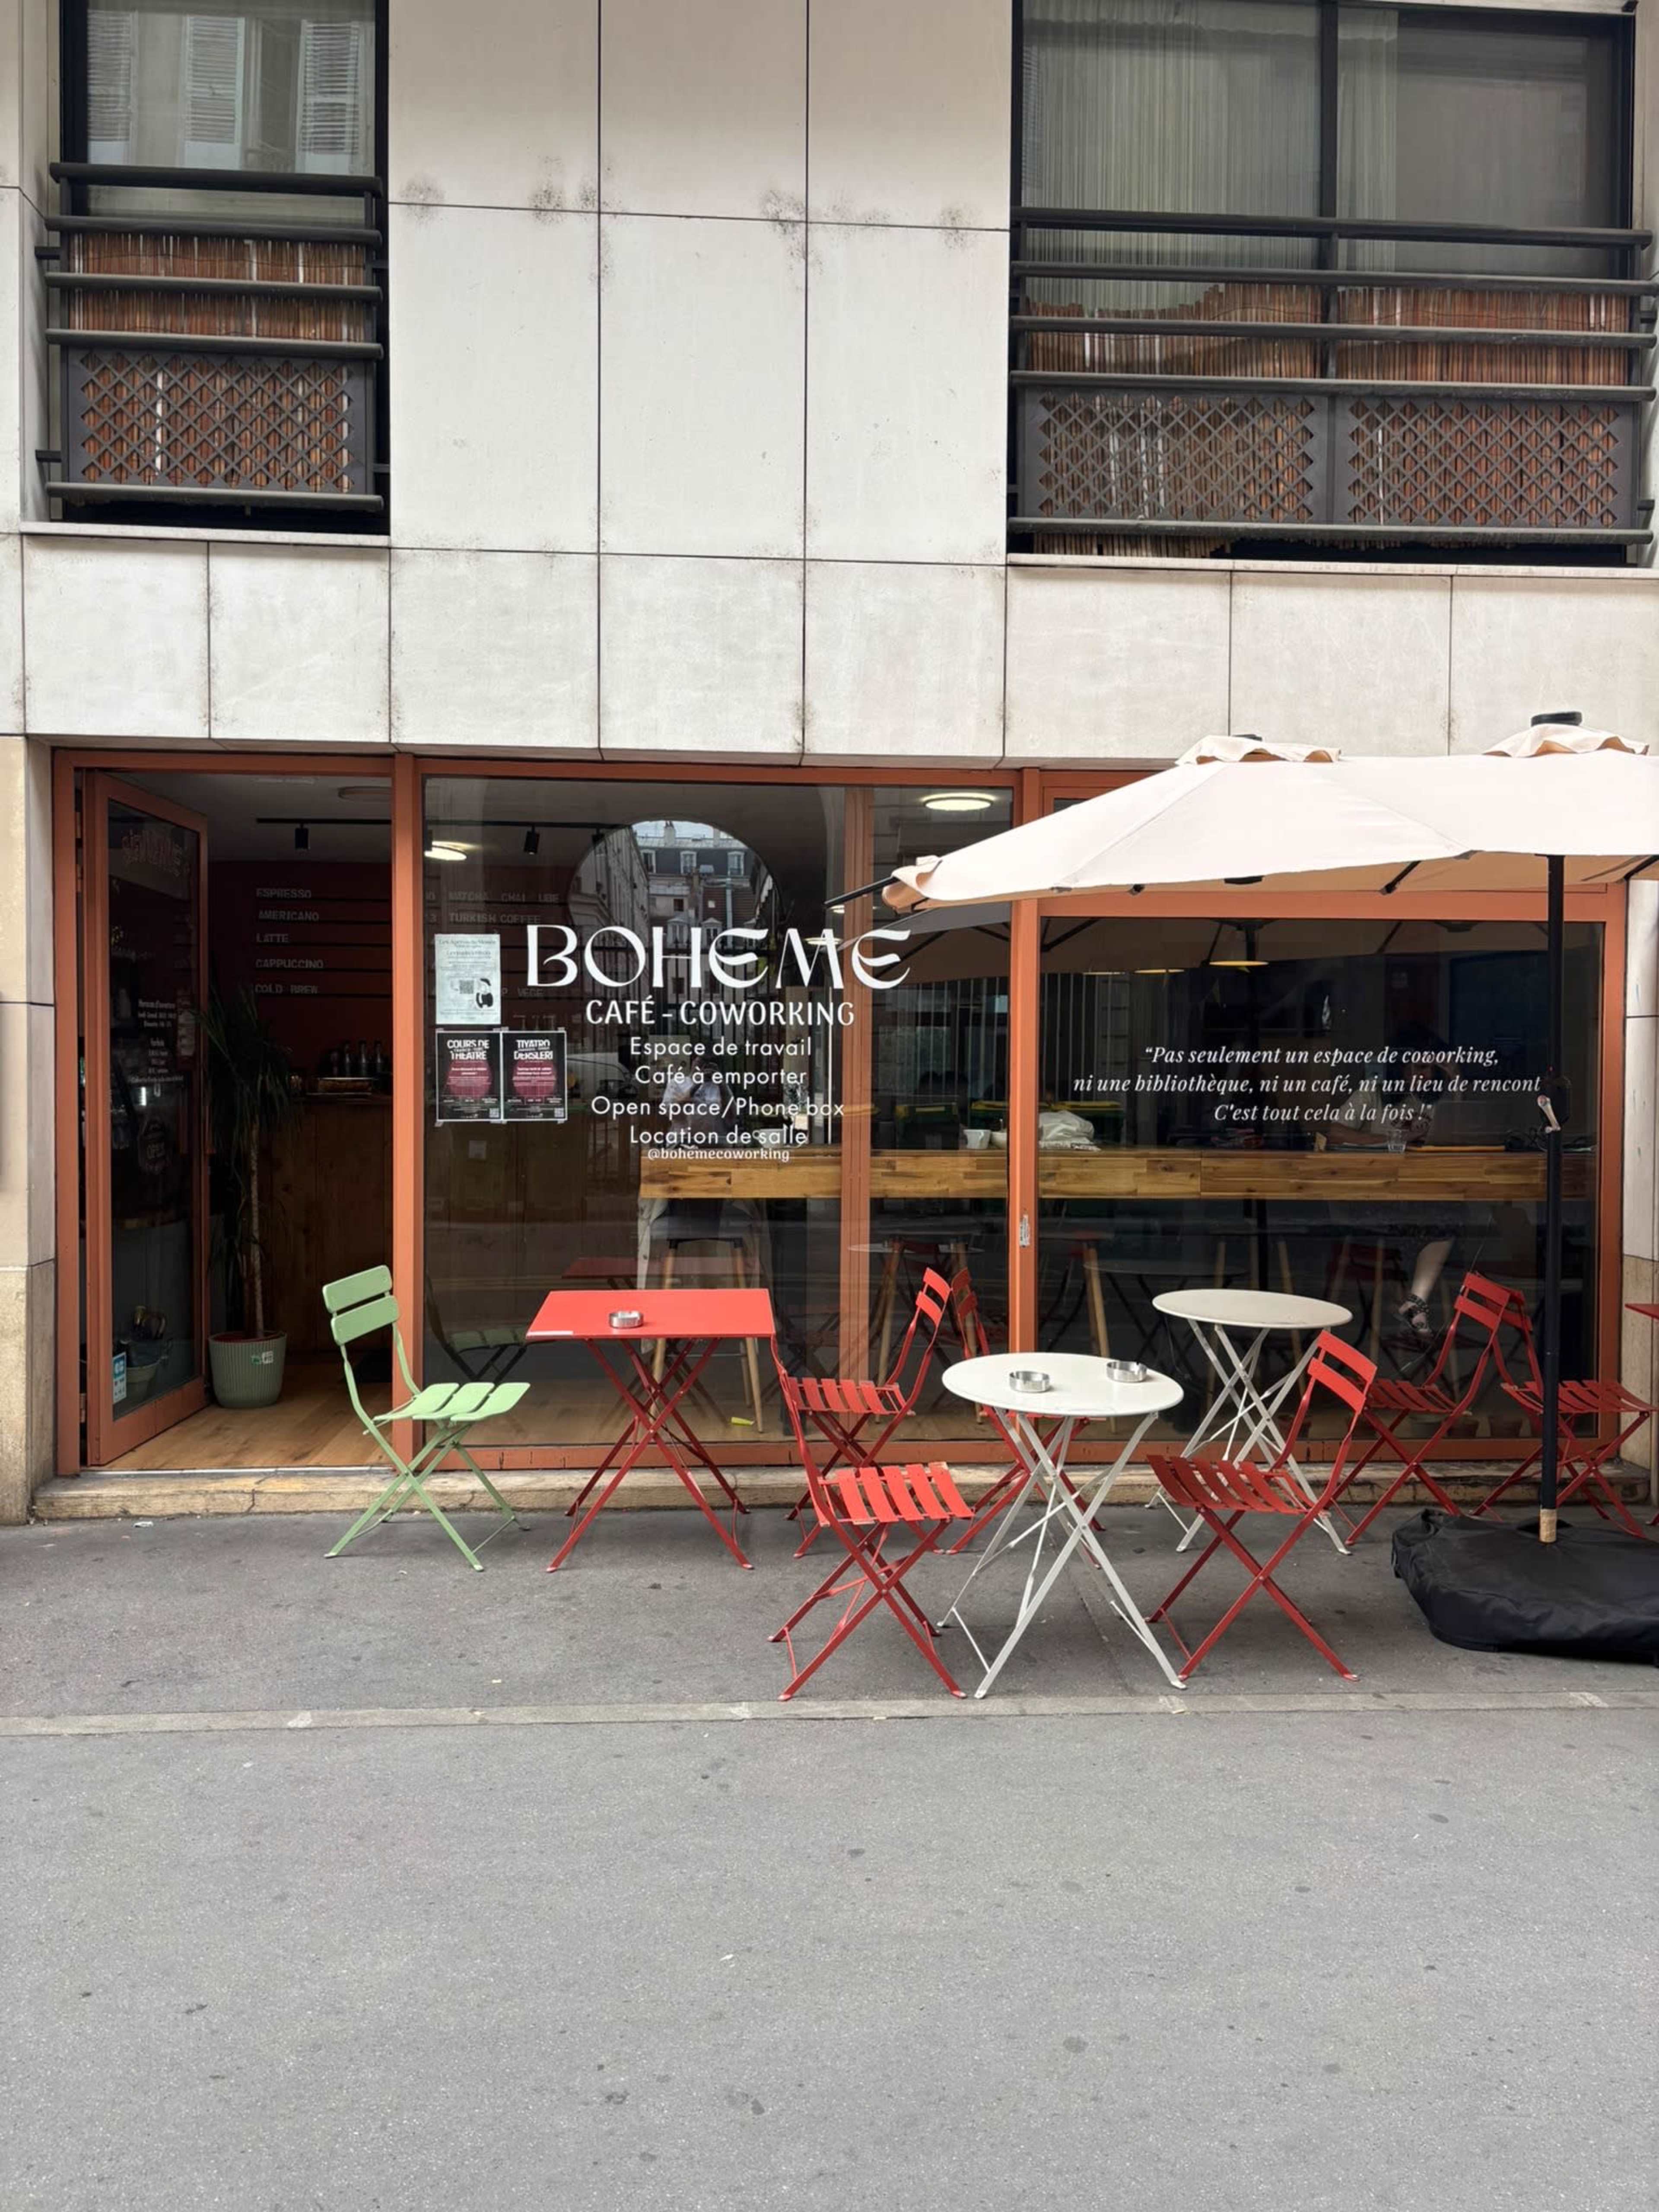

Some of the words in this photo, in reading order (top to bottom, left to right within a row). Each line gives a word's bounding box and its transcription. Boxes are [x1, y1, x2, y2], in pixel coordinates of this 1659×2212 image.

[256, 888, 311, 899] ESPRESSO
[258, 909, 319, 921] AMERICANO
[449, 912, 496, 923] TURKISH
[500, 915, 541, 923] COFFEE
[256, 933, 289, 943] LATTE
[255, 958, 324, 969] CAPPUCCINO
[527, 925, 912, 989] BOHEME
[254, 984, 283, 994] COLD
[586, 995, 655, 1024] CAFÉ
[680, 1001, 855, 1026] COWORKING
[446, 1039, 477, 1049] COURS
[478, 1039, 490, 1049] DE
[631, 1037, 705, 1060] Espace
[713, 1036, 737, 1055] de
[745, 1037, 811, 1055] travail
[1145, 1047, 1185, 1063] “Pas
[1188, 1047, 1280, 1063] seulement
[1286, 1051, 1309, 1063] un
[1313, 1049, 1373, 1066] espace
[1377, 1047, 1398, 1063] de
[1402, 1047, 1498, 1066] coworking,
[635, 1064, 685, 1084] Café
[693, 1066, 704, 1084] à
[712, 1069, 807, 1087] emporter
[1074, 1075, 1093, 1091] ni
[1097, 1080, 1130, 1091] une
[1135, 1074, 1252, 1095] bibliothèque,
[1260, 1075, 1279, 1091] ni
[1284, 1080, 1306, 1091] un
[1311, 1075, 1353, 1095] café,
[1359, 1075, 1378, 1091] ni
[1382, 1080, 1405, 1091] un
[1409, 1075, 1443, 1091] lieu
[1448, 1075, 1468, 1091] de
[1472, 1076, 1541, 1091] rencont
[591, 1096, 650, 1120] Open
[659, 1095, 799, 1121] space/Phone
[806, 1096, 845, 1116] box
[1214, 1104, 1257, 1120] C'est
[1262, 1106, 1299, 1120] tout
[1304, 1104, 1340, 1120] cela
[1344, 1103, 1355, 1120] à
[1360, 1104, 1376, 1120] la
[1381, 1104, 1414, 1123] fois
[630, 1125, 718, 1144] Location
[726, 1125, 751, 1144] de
[759, 1125, 808, 1145] salle
[647, 1147, 790, 1163] @bohemecoworking
